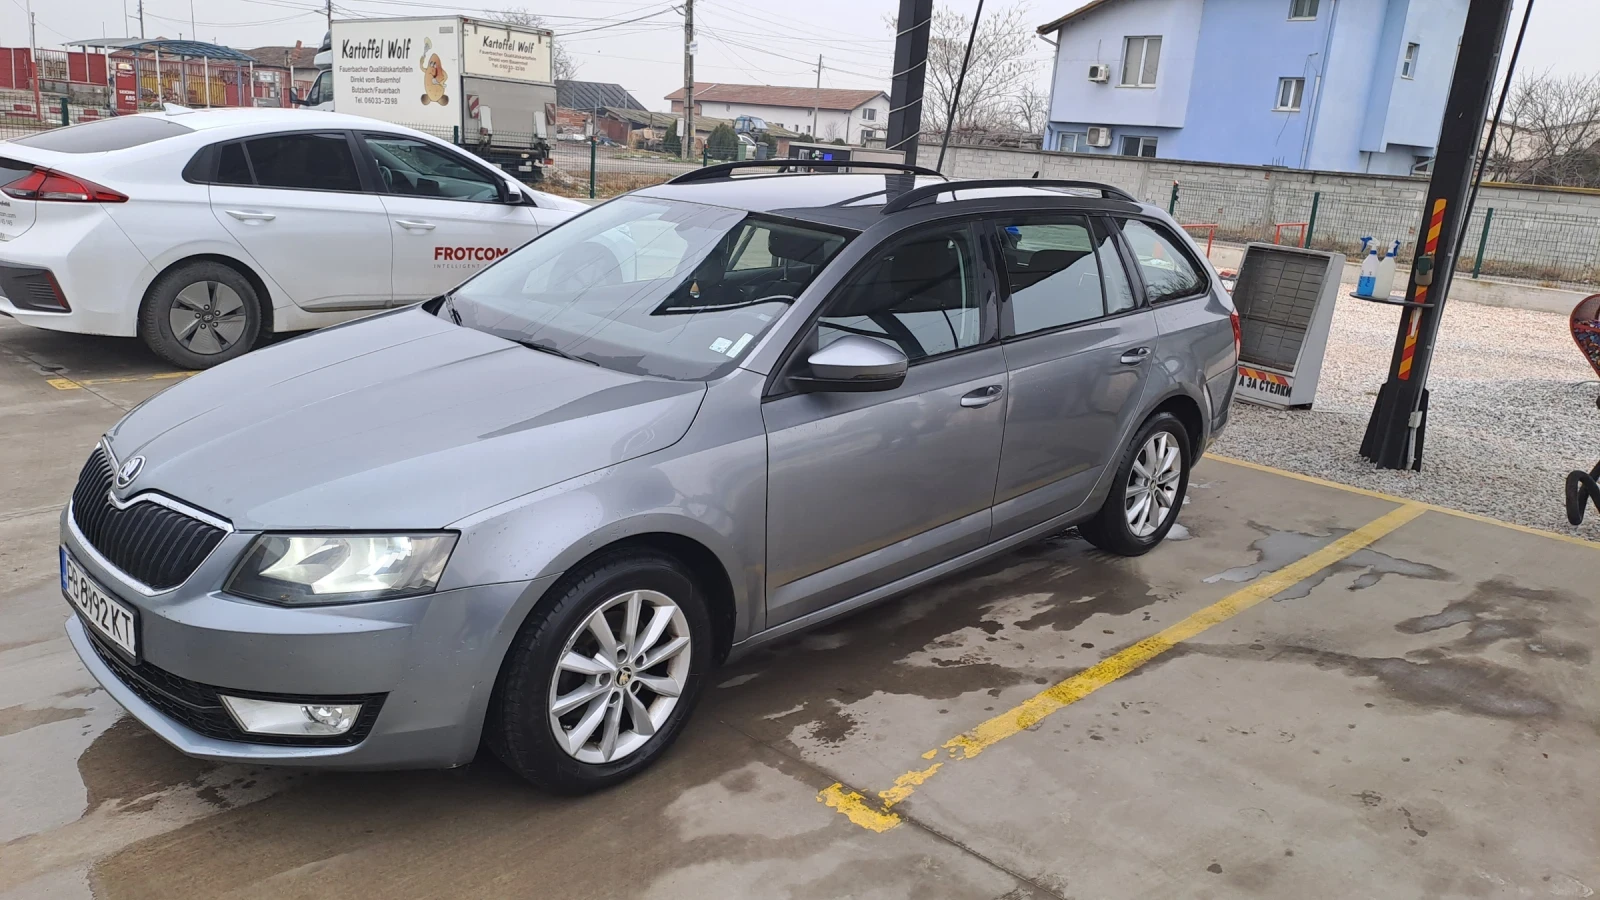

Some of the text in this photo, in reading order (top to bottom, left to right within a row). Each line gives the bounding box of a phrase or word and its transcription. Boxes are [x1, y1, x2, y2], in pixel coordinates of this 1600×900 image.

[342, 38, 411, 59] Kartoffel Wolf
[483, 36, 534, 54] Kartoffel Wolf
[434, 247, 508, 260] FROTCOM
[1247, 378, 1257, 389] ЗА
[1259, 380, 1292, 398] СТЕЛКИ
